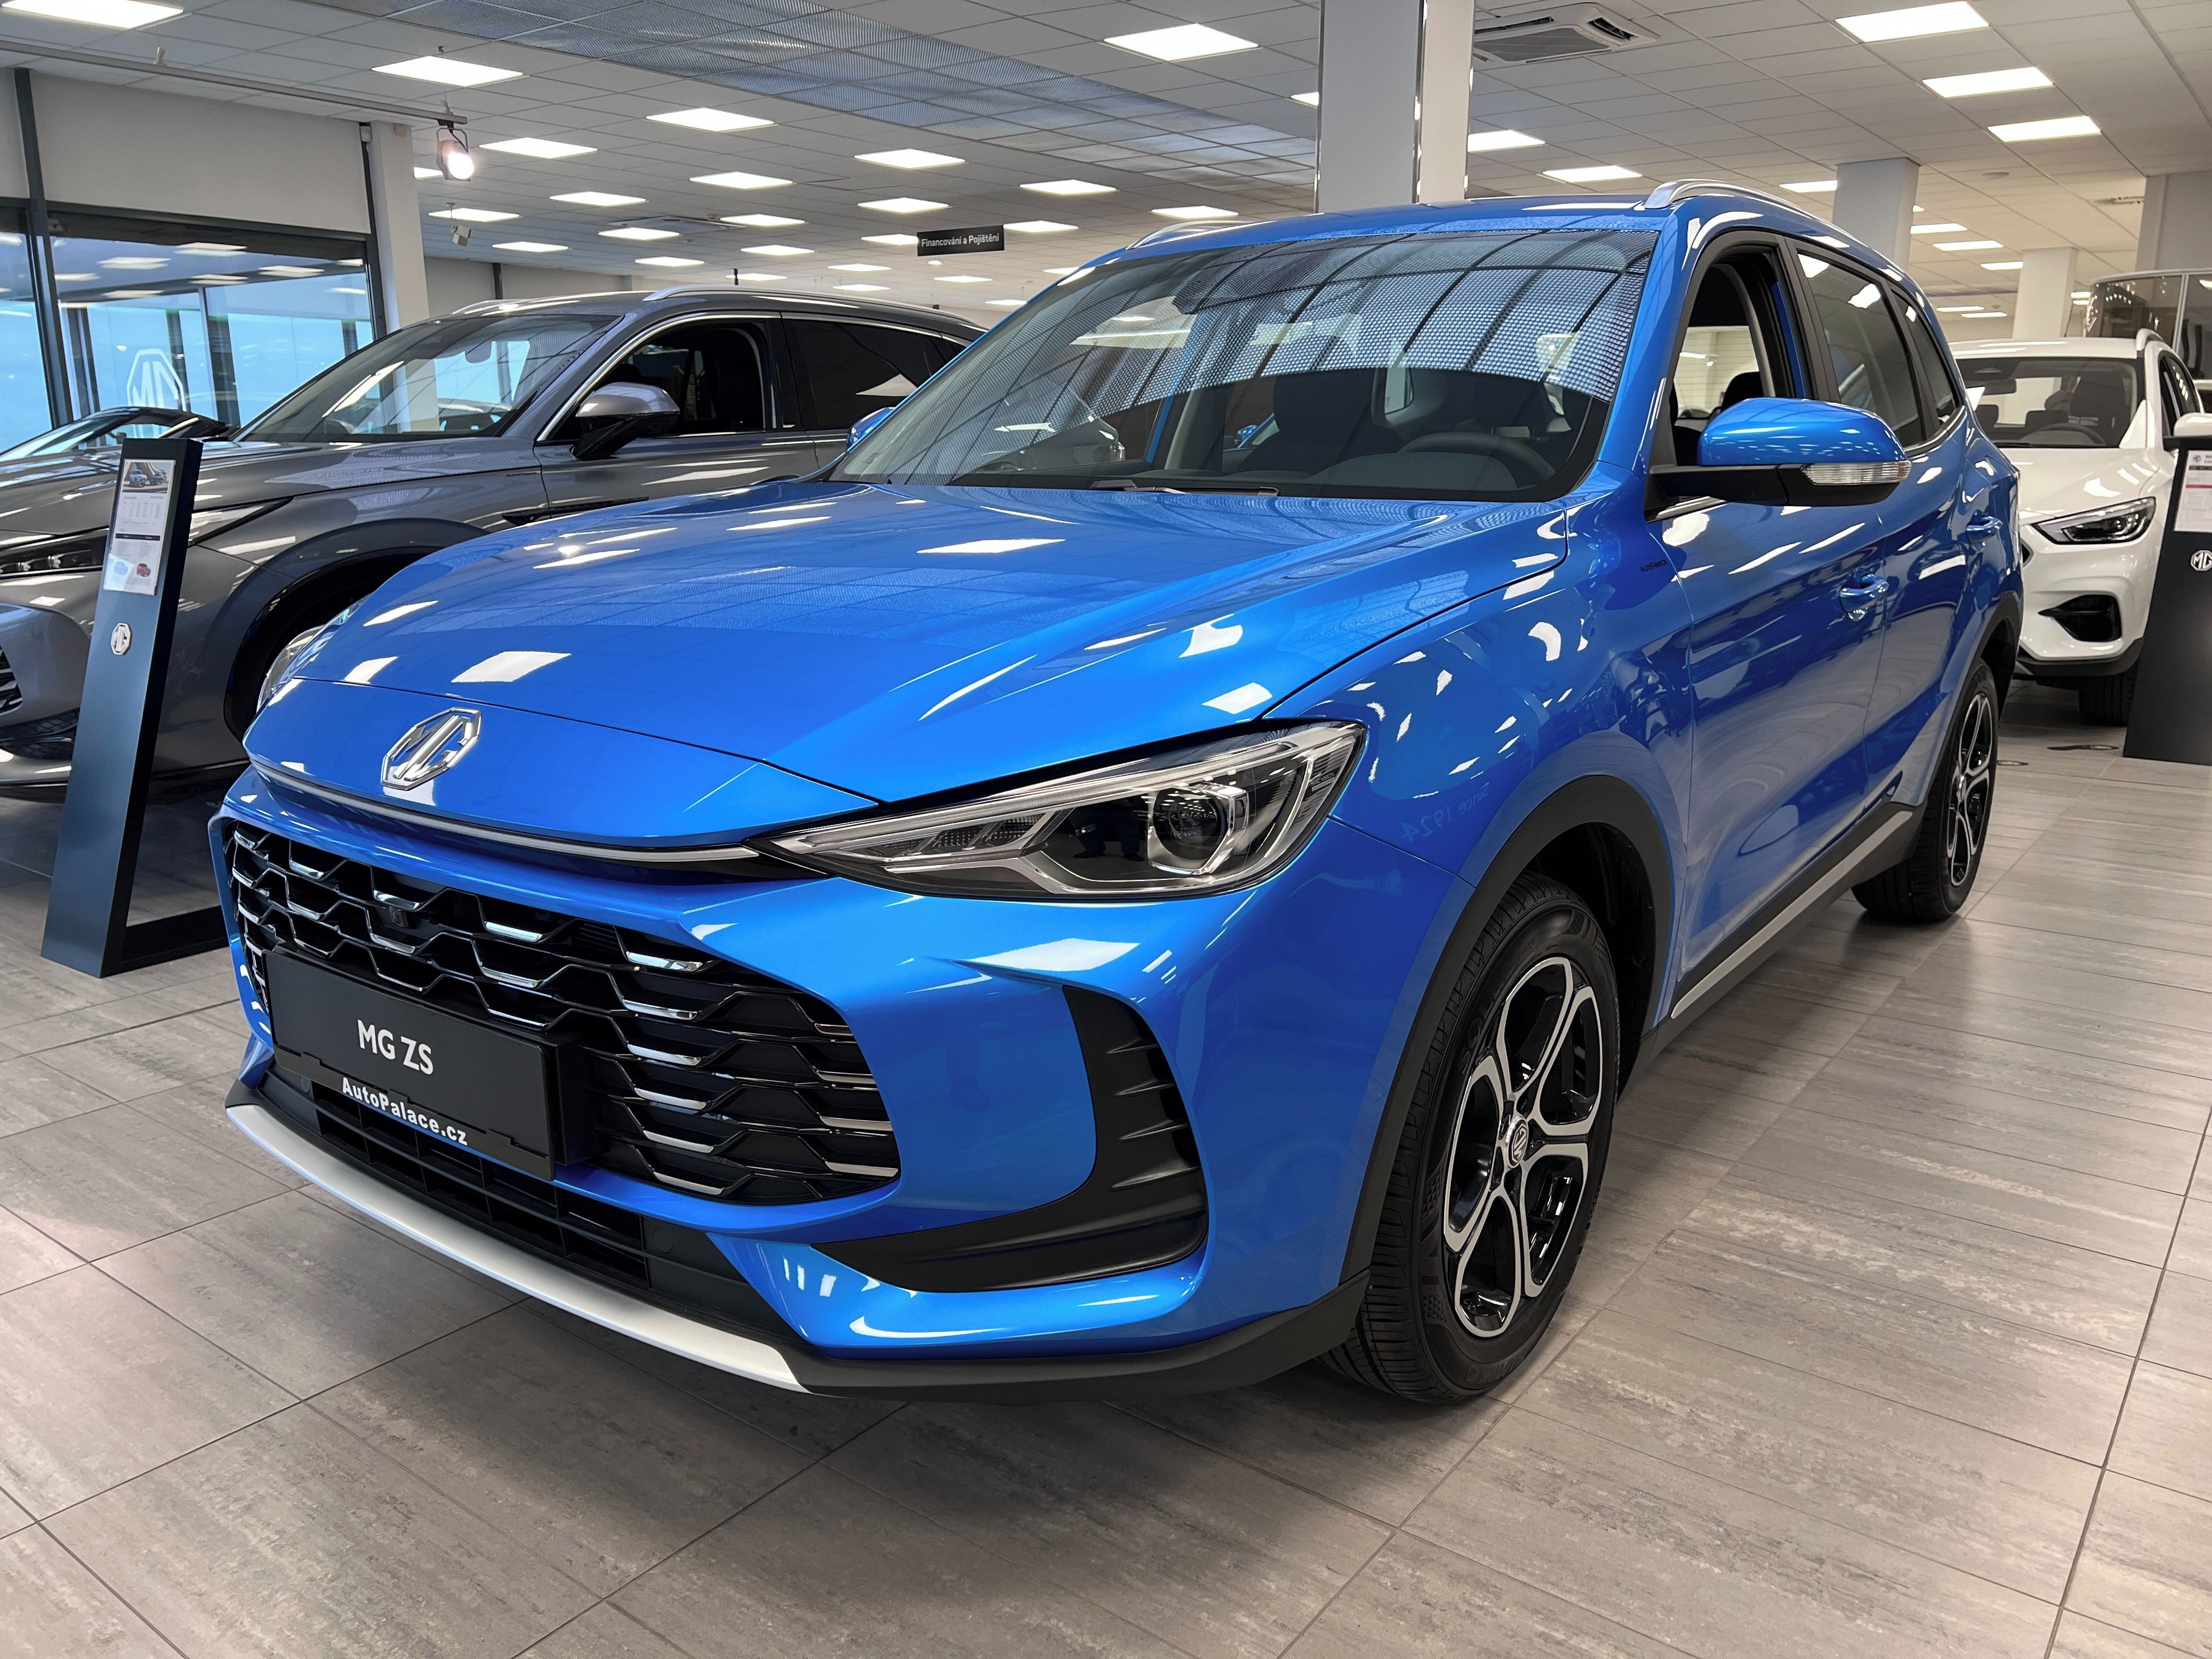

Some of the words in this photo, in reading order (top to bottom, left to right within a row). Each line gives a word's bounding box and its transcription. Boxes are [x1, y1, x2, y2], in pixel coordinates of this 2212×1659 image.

[921, 236, 962, 247] Financování
[968, 233, 1000, 245] Pojištění
[2193, 552, 2212, 569] MG
[388, 712, 474, 783] MG
[358, 1019, 396, 1060] MG
[400, 1036, 433, 1075] ZS
[342, 1077, 467, 1146] AutoPalace.cz
